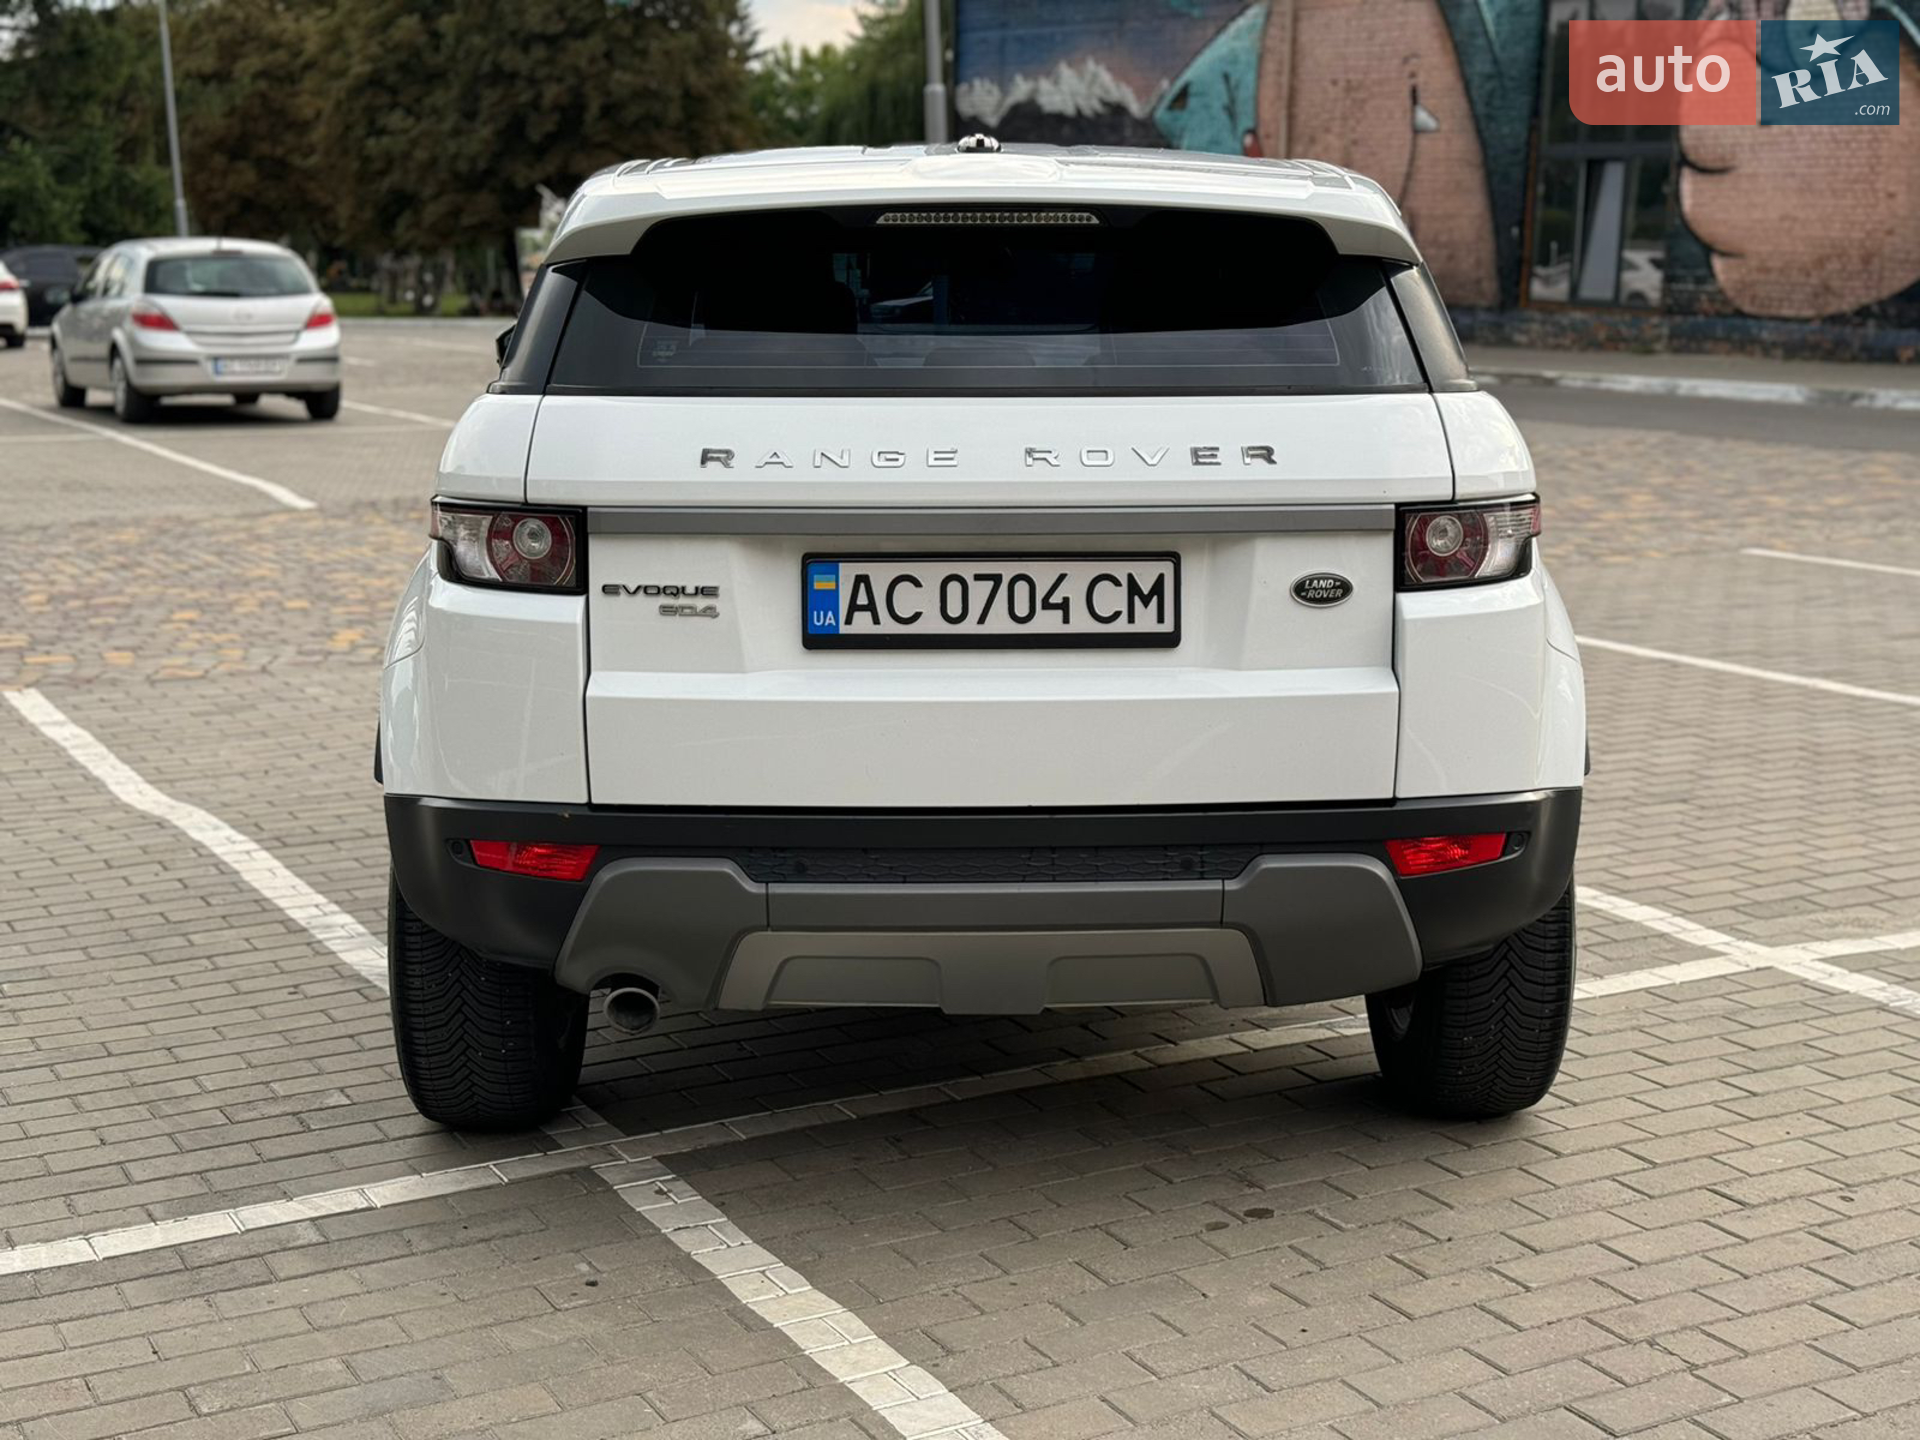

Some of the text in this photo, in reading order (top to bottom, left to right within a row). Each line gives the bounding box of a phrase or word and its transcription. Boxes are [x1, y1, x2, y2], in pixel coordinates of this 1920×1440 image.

[700, 445, 1278, 469] RANGE ROVER
[601, 584, 720, 599] EVOQUE
[843, 572, 1166, 626] AC 0704 CM
[813, 610, 836, 626] UA
